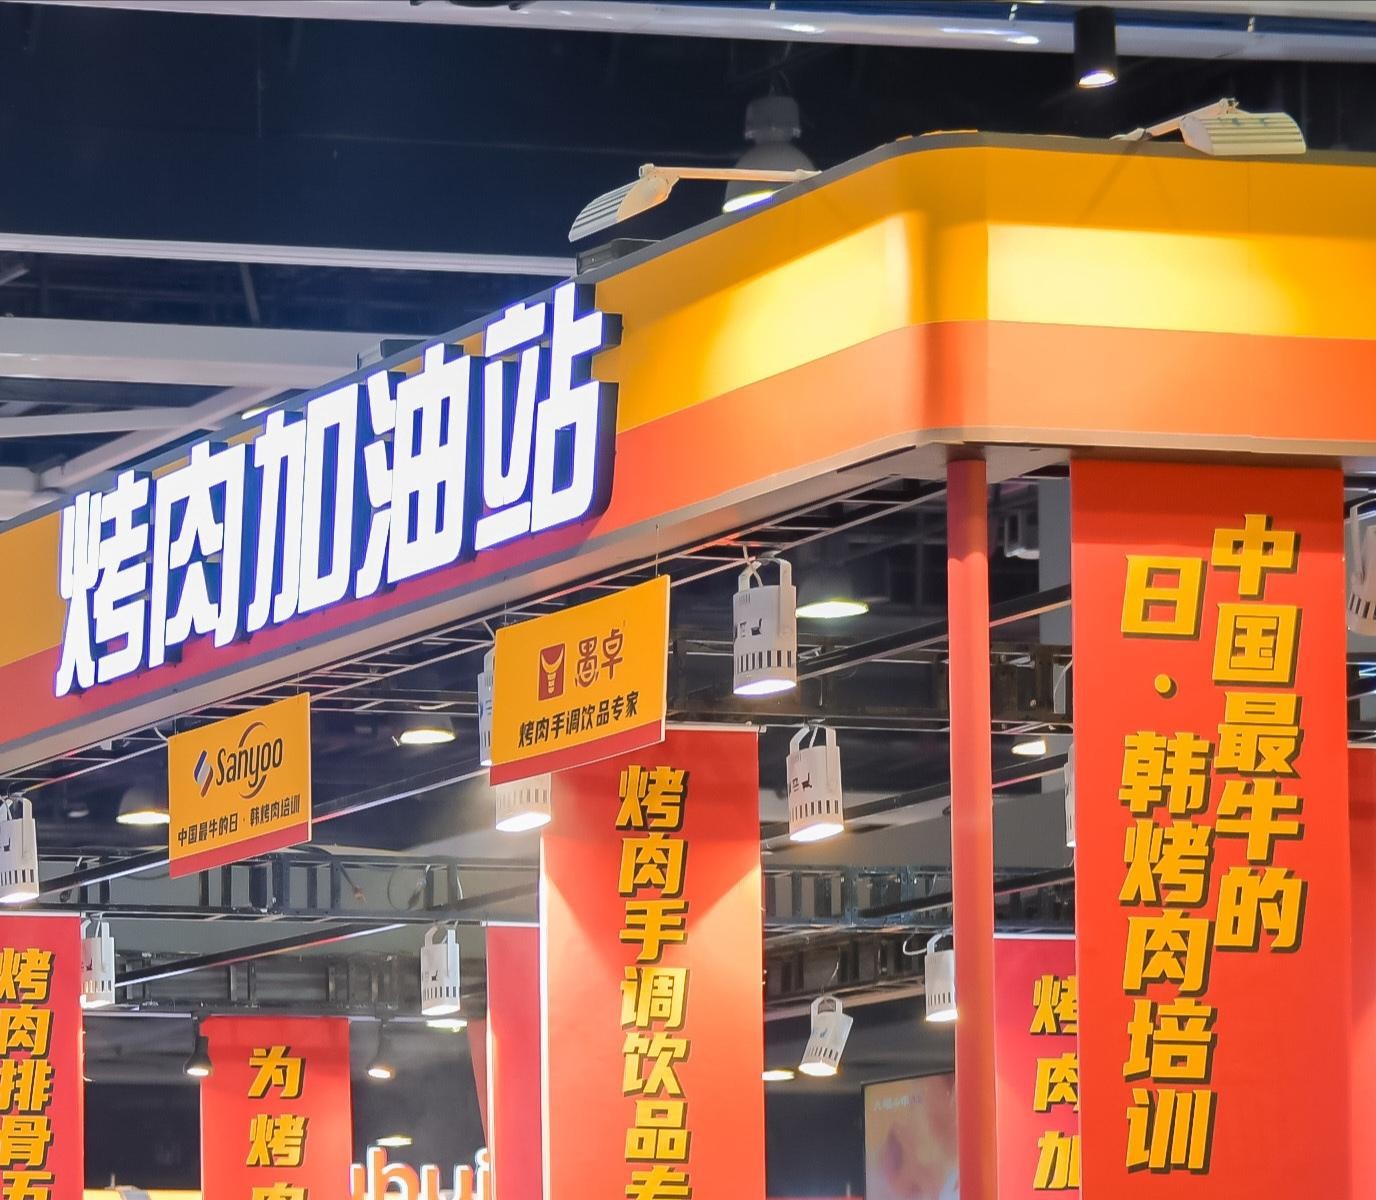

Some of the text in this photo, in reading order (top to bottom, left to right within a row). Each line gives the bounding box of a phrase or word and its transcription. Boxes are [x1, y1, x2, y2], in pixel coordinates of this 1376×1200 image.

[55, 282, 604, 697] 烤肉加油站
[215, 736, 283, 788] Sanyoo
[517, 692, 639, 750] 烤肉手调饮品专家
[573, 628, 626, 689] 愚卓
[1211, 513, 1306, 951] 中国最牛的
[1118, 554, 1216, 1173] 日·韩烤肉培训
